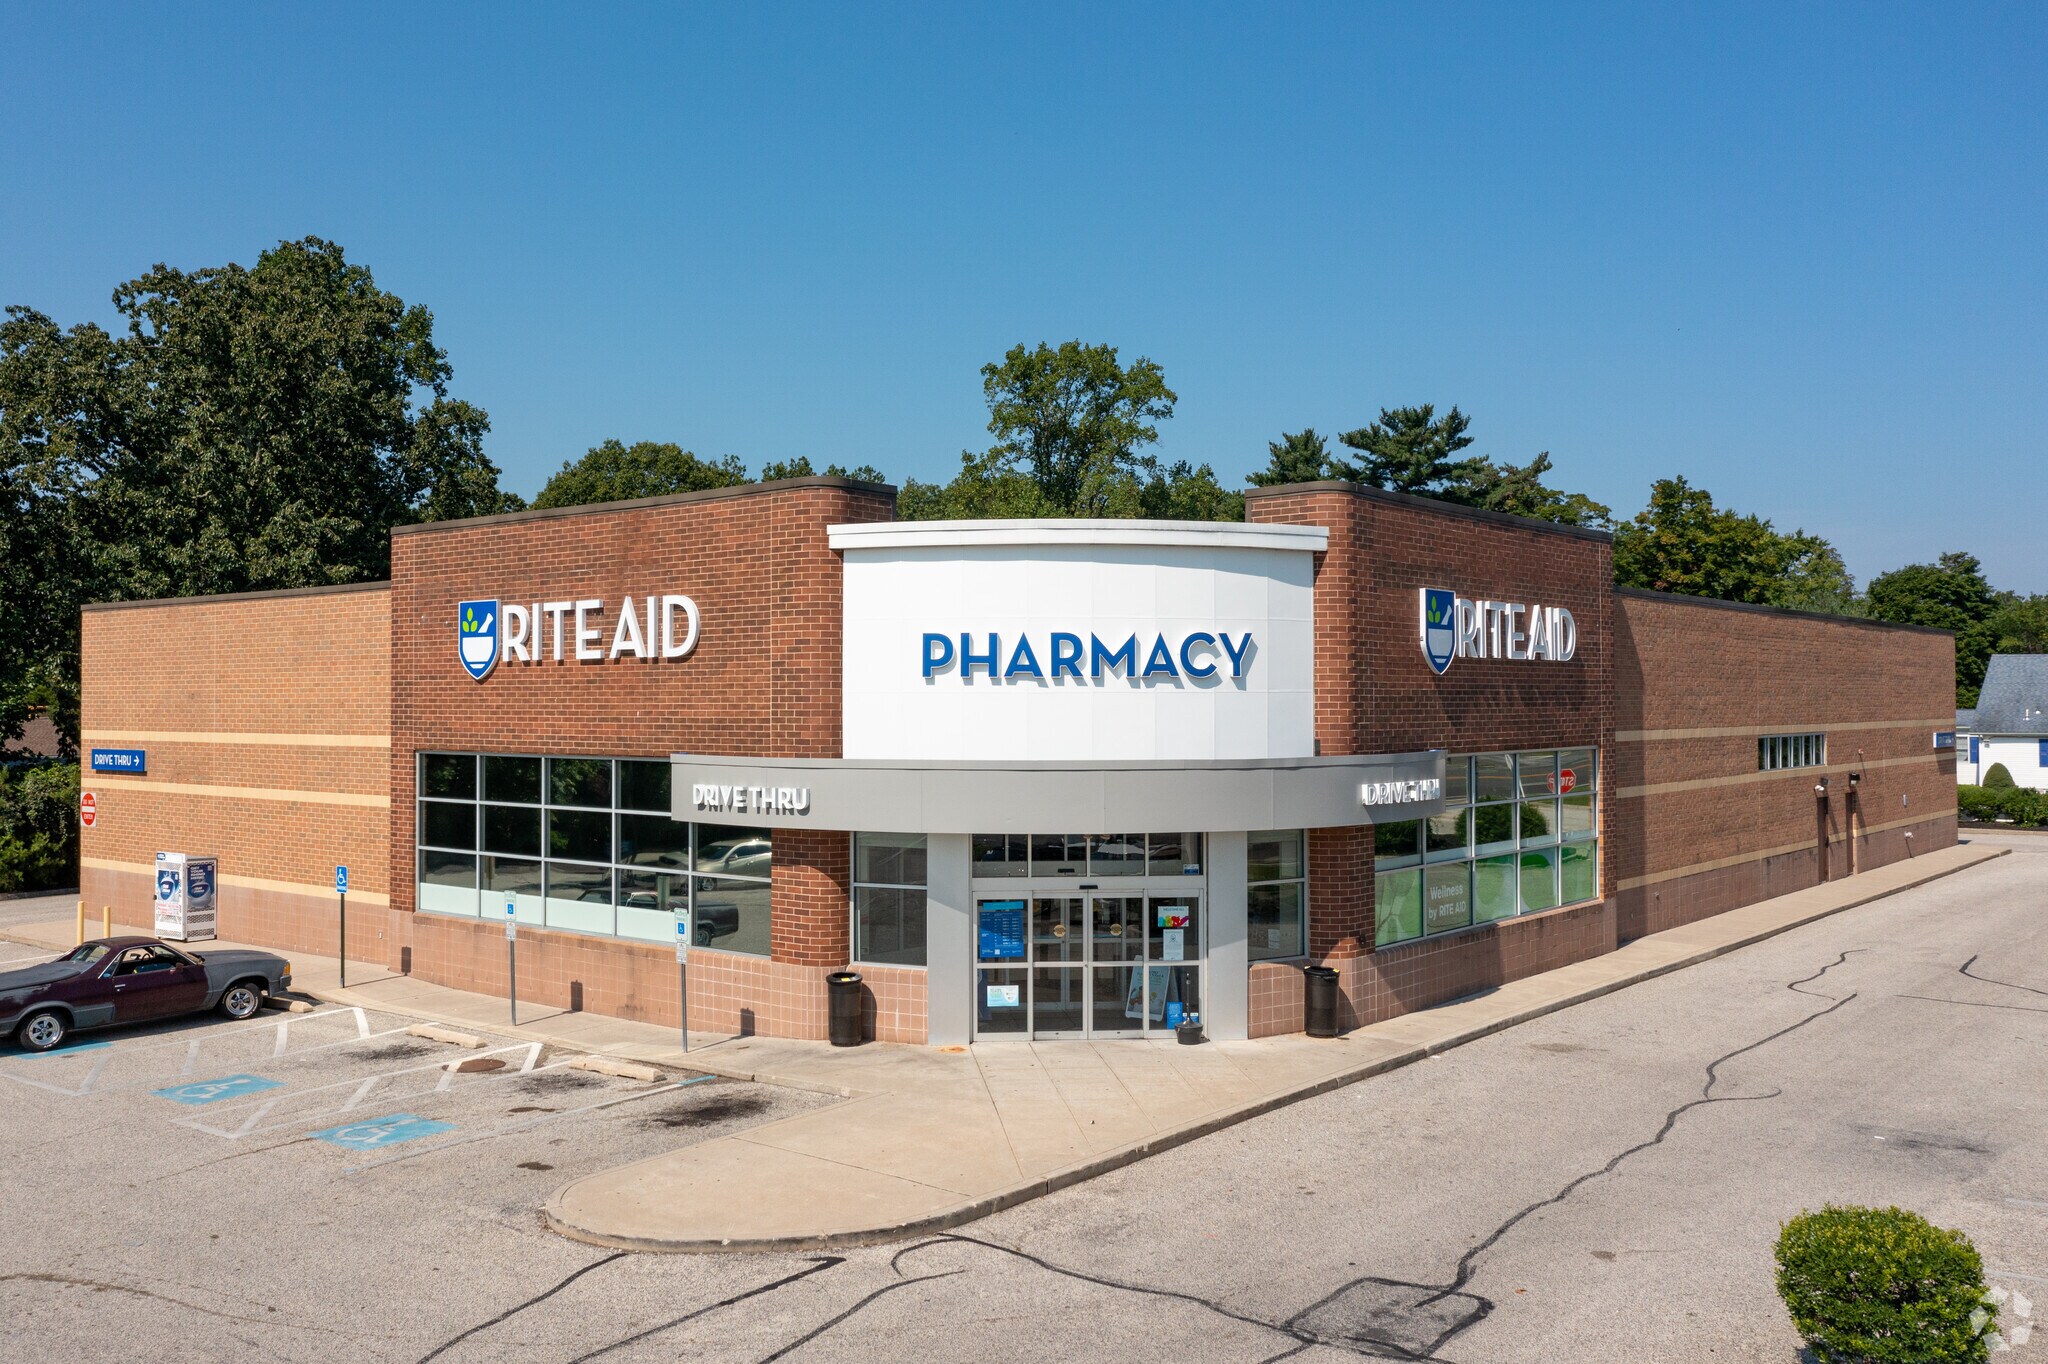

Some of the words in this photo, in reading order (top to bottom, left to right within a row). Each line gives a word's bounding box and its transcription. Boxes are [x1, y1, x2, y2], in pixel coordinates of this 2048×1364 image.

[502, 600, 605, 662] RITE
[609, 595, 700, 658] AID
[1456, 598, 1527, 659] RITE
[1527, 604, 1576, 661] AID
[922, 631, 1254, 679] PHARMACY
[94, 754, 113, 765] DRIVE
[114, 754, 132, 766] THRU
[692, 784, 747, 807] DRIVE
[749, 787, 810, 810] THRU
[1361, 783, 1411, 805] DRIVE
[1430, 884, 1464, 900] Wellness
[1428, 907, 1437, 921] by
[1439, 903, 1454, 917] RITE
[1455, 900, 1467, 913] AID
